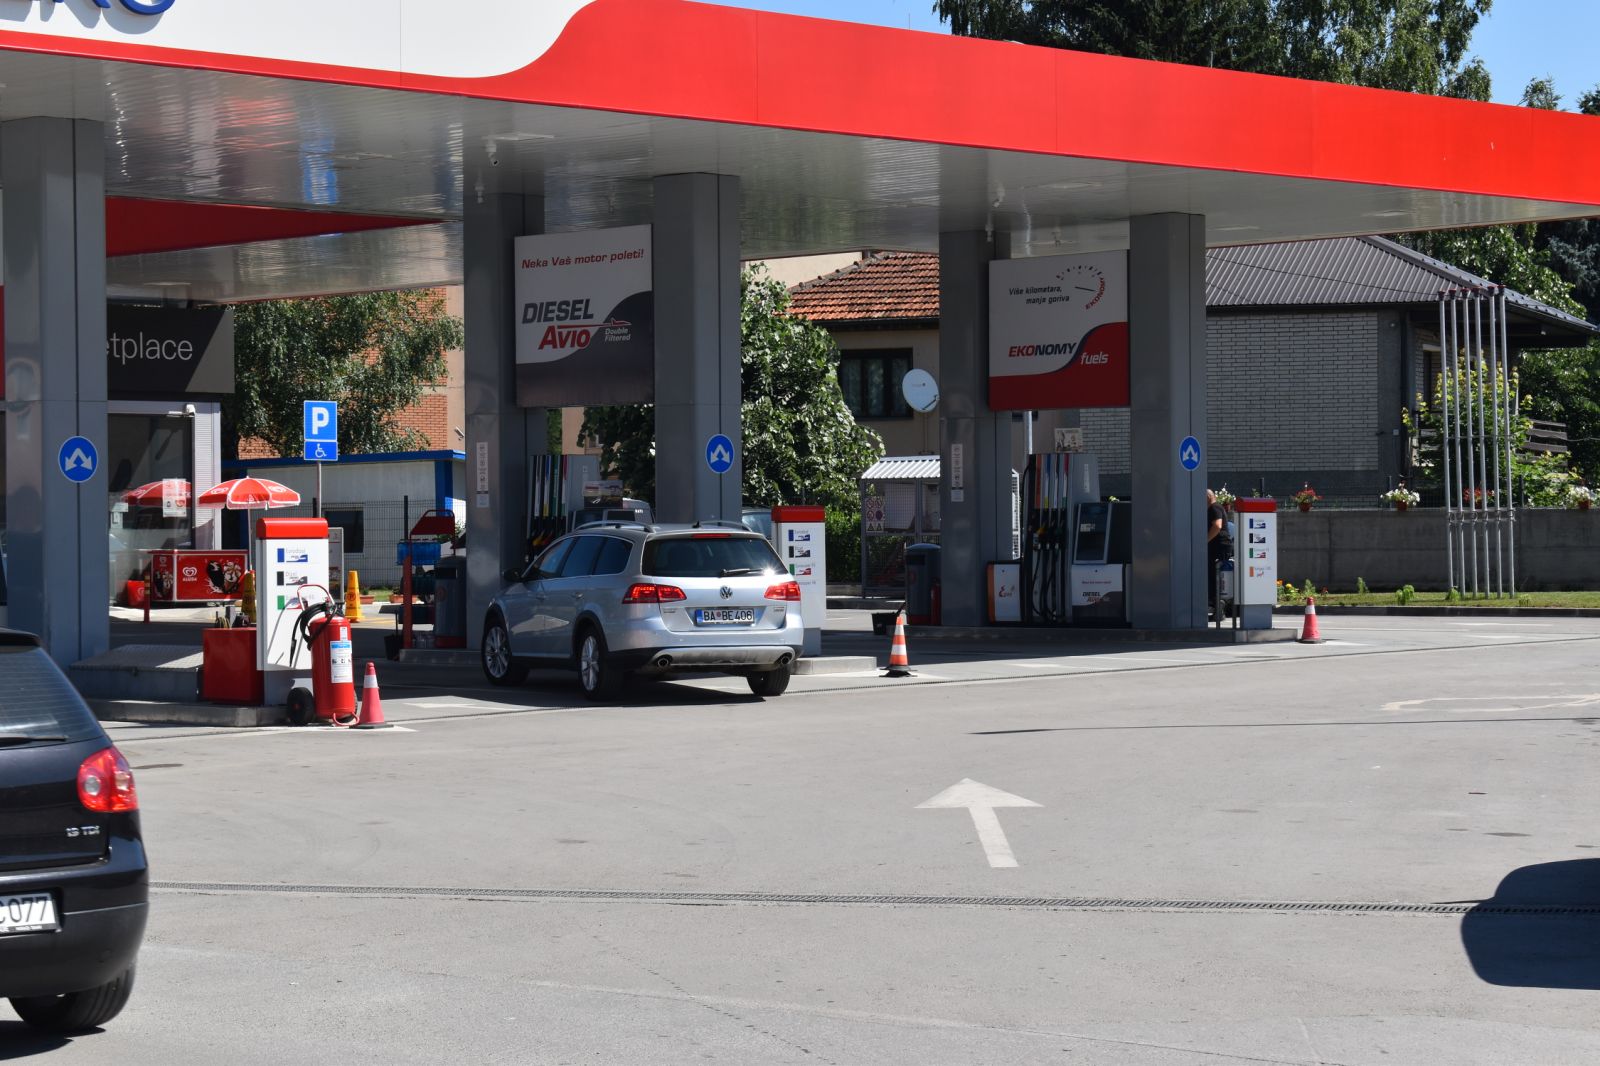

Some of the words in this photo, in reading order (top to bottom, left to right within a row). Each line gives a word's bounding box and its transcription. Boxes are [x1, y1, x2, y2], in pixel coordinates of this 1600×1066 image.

[521, 259, 548, 269] Neka
[551, 256, 572, 267] Vaš
[574, 253, 607, 265] motor
[609, 248, 645, 264] poleti!
[522, 299, 594, 324] DIESEL
[1008, 342, 1077, 358] EKONOMY
[1080, 352, 1109, 365] fuels
[312, 407, 330, 435] P
[703, 610, 716, 621] BA
